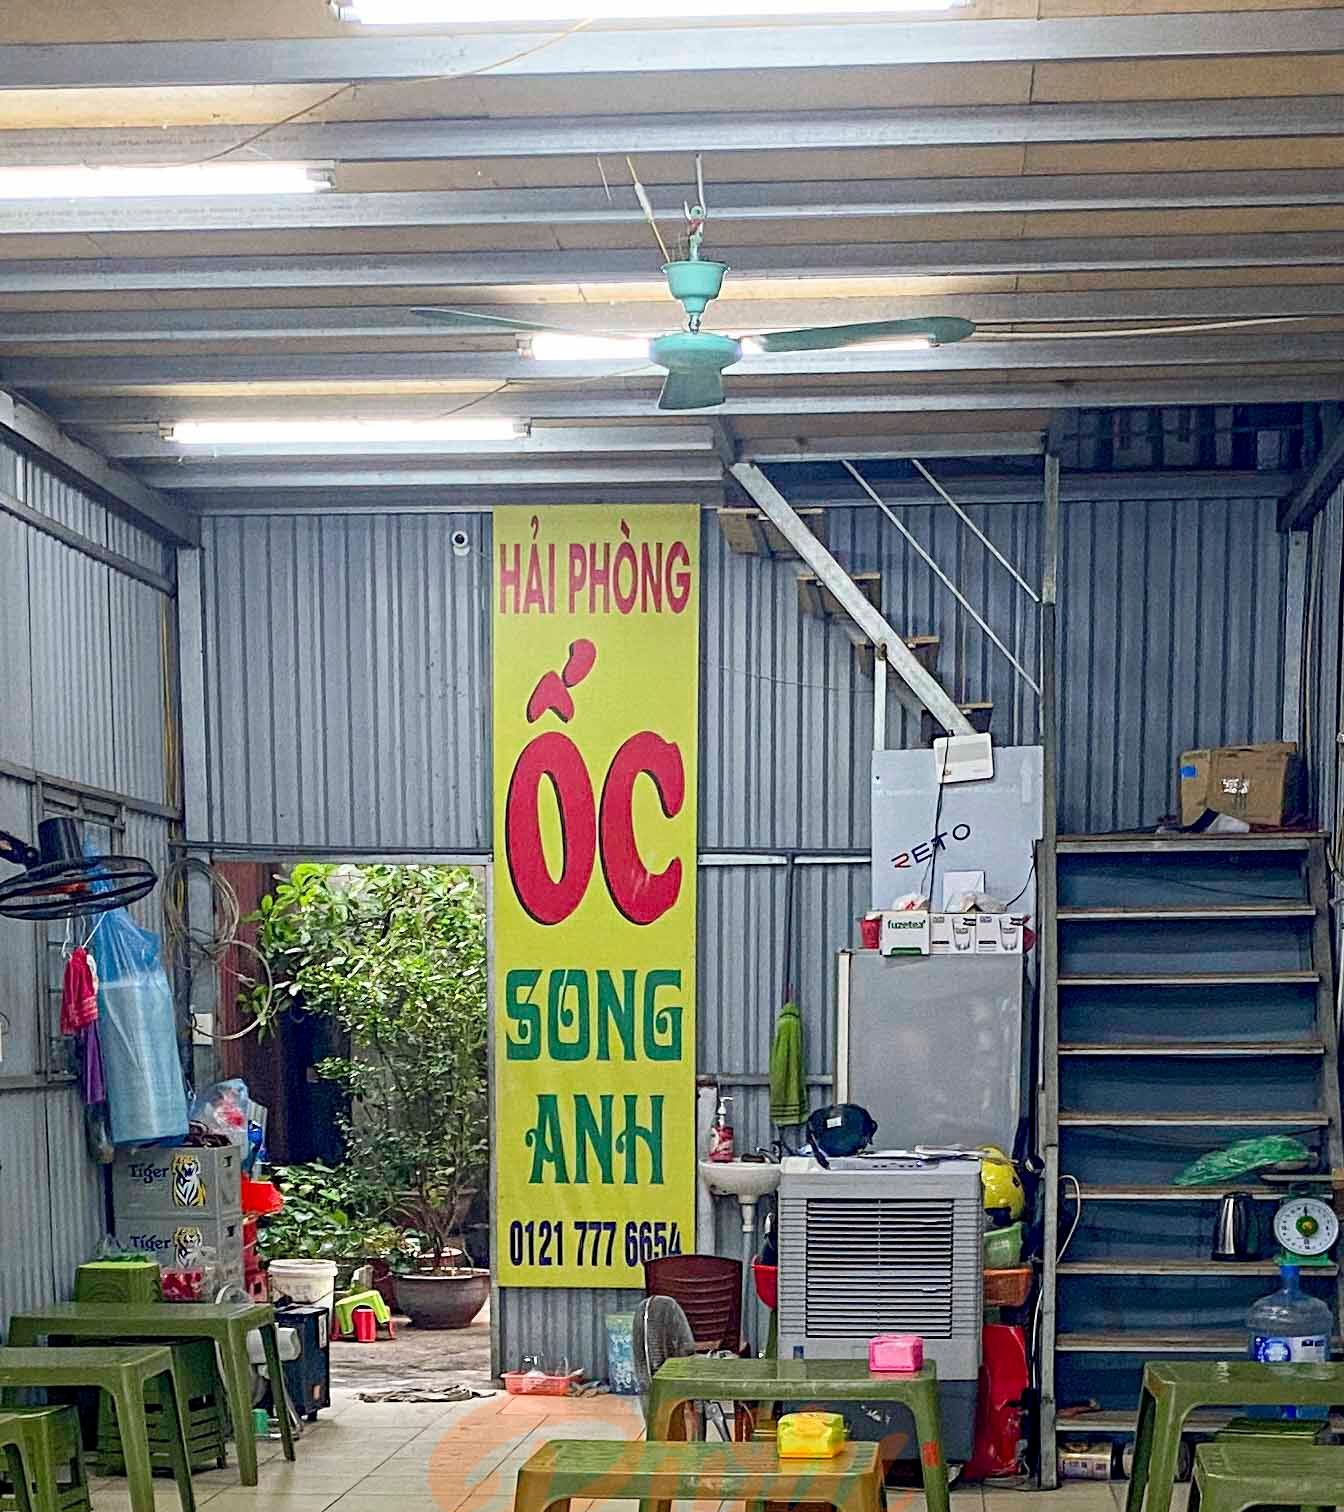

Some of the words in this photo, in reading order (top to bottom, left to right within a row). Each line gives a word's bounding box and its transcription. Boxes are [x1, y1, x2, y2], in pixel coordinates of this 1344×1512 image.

[500, 517, 556, 615] HẢI
[568, 518, 692, 616] PHÒNG
[504, 639, 685, 926] ỐC
[505, 968, 684, 1062] SONG
[127, 1163, 170, 1184] Tiger
[524, 1094, 665, 1186] ANH
[130, 1235, 172, 1252] Tiger
[509, 1220, 564, 1267] 0121
[574, 1220, 617, 1267] 777
